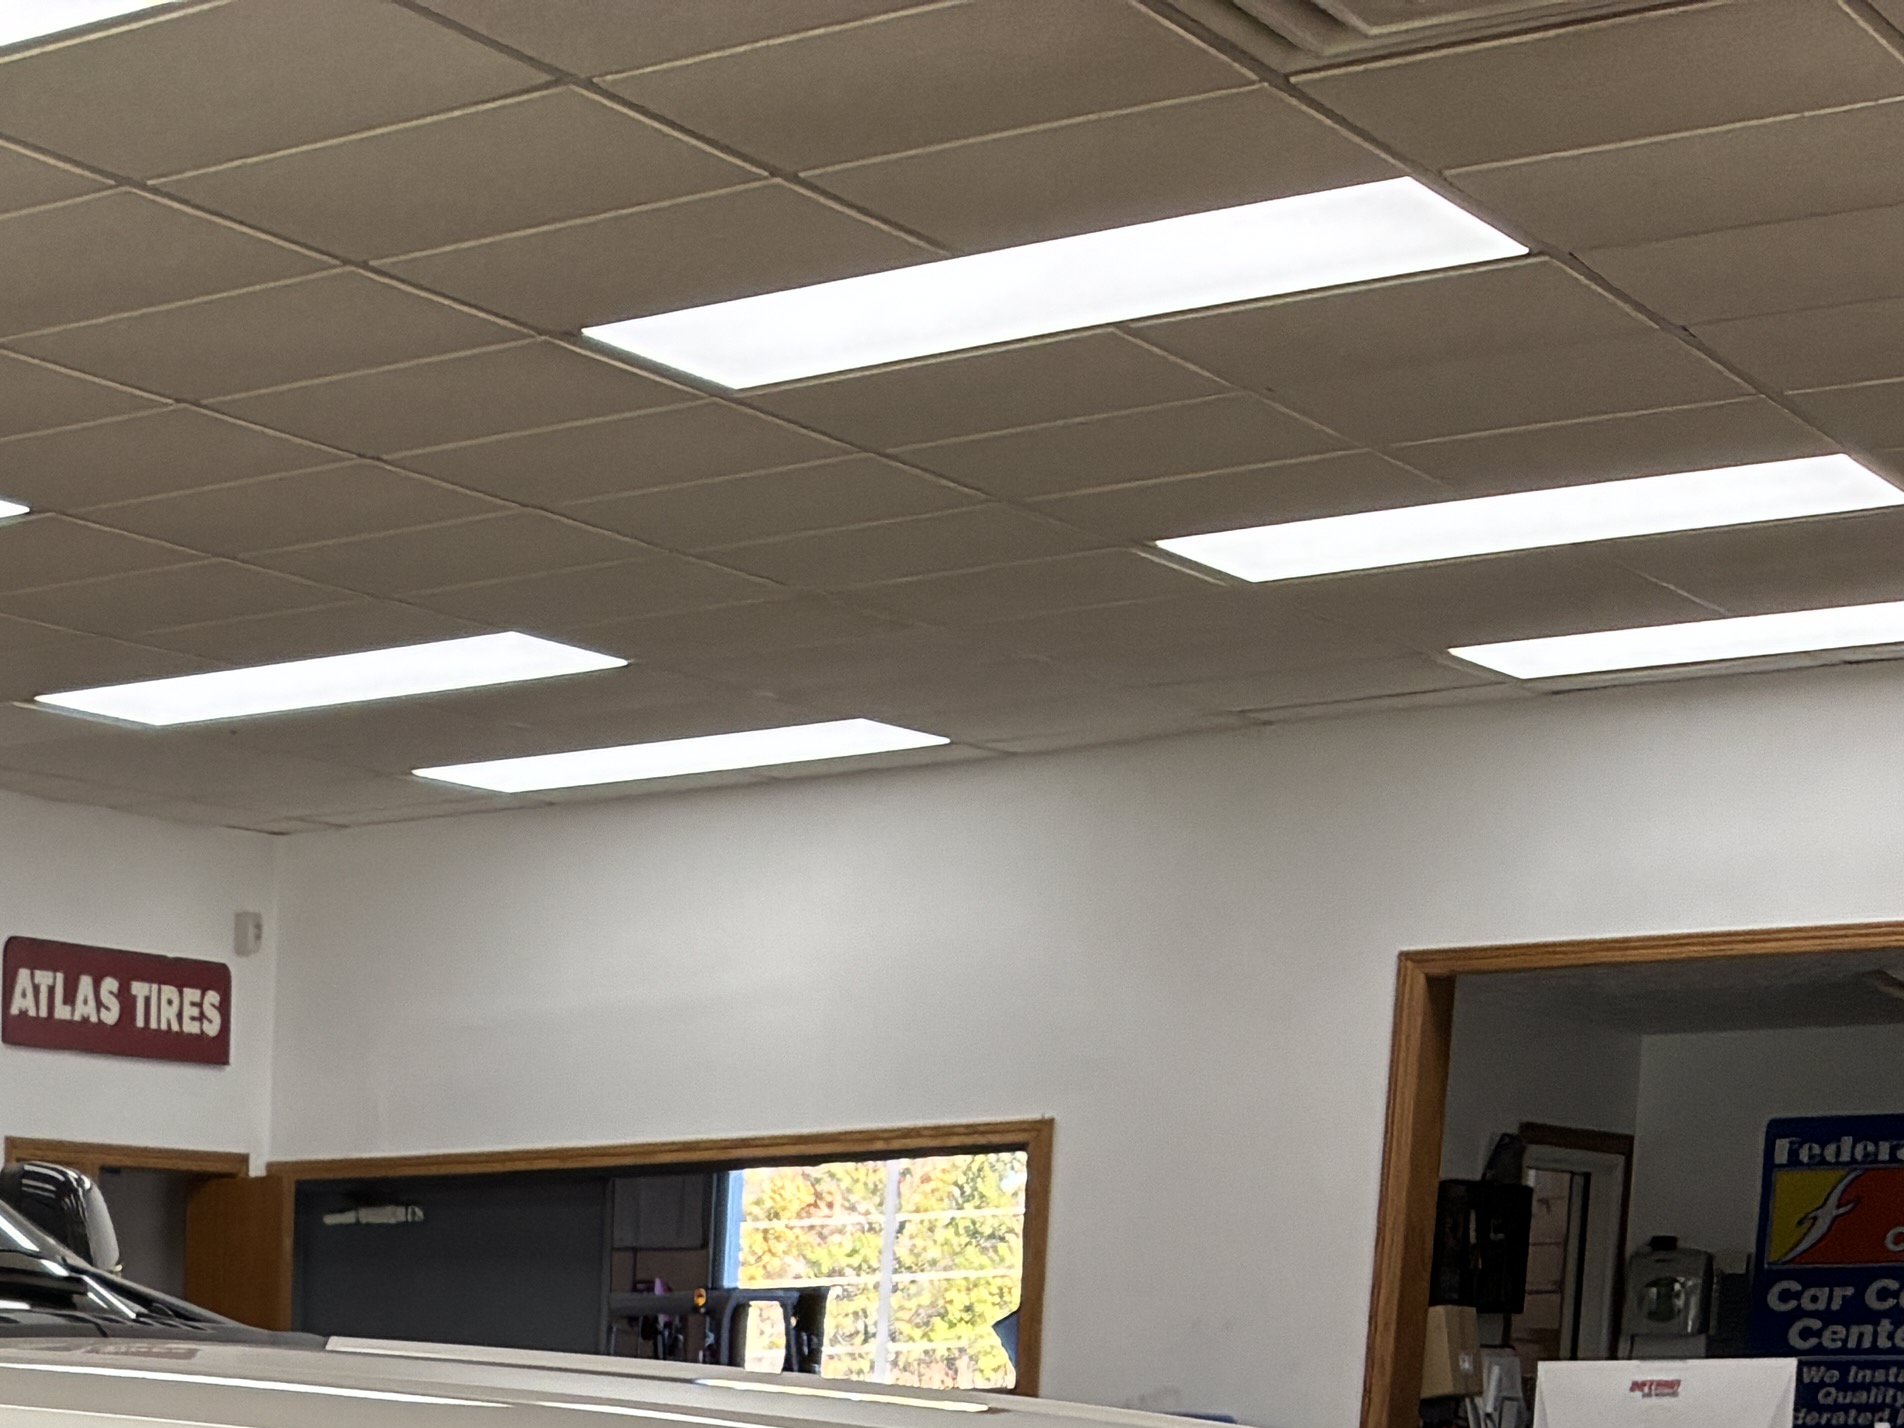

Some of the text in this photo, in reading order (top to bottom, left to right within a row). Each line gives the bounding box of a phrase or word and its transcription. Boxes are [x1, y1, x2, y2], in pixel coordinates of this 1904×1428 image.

[10, 967, 222, 1038] ATLAS TIRES
[1766, 1278, 1904, 1312] Car C
